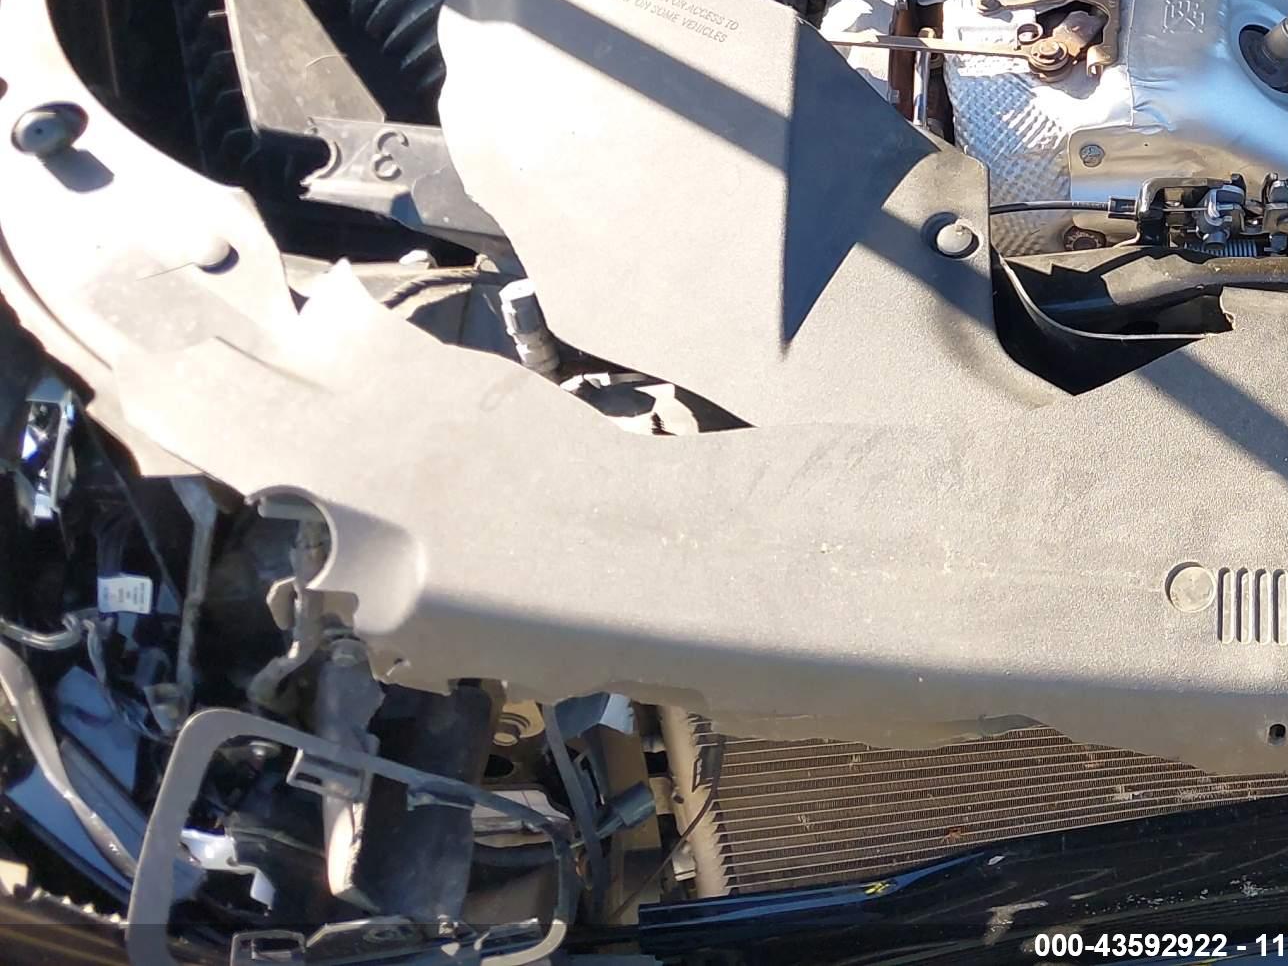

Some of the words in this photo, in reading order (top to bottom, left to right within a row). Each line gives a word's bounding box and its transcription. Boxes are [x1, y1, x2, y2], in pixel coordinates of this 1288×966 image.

[650, 5, 680, 23] SOME
[682, 17, 728, 43] VEHICLES
[685, 4, 725, 25] ACCESS
[724, 18, 739, 31] TO
